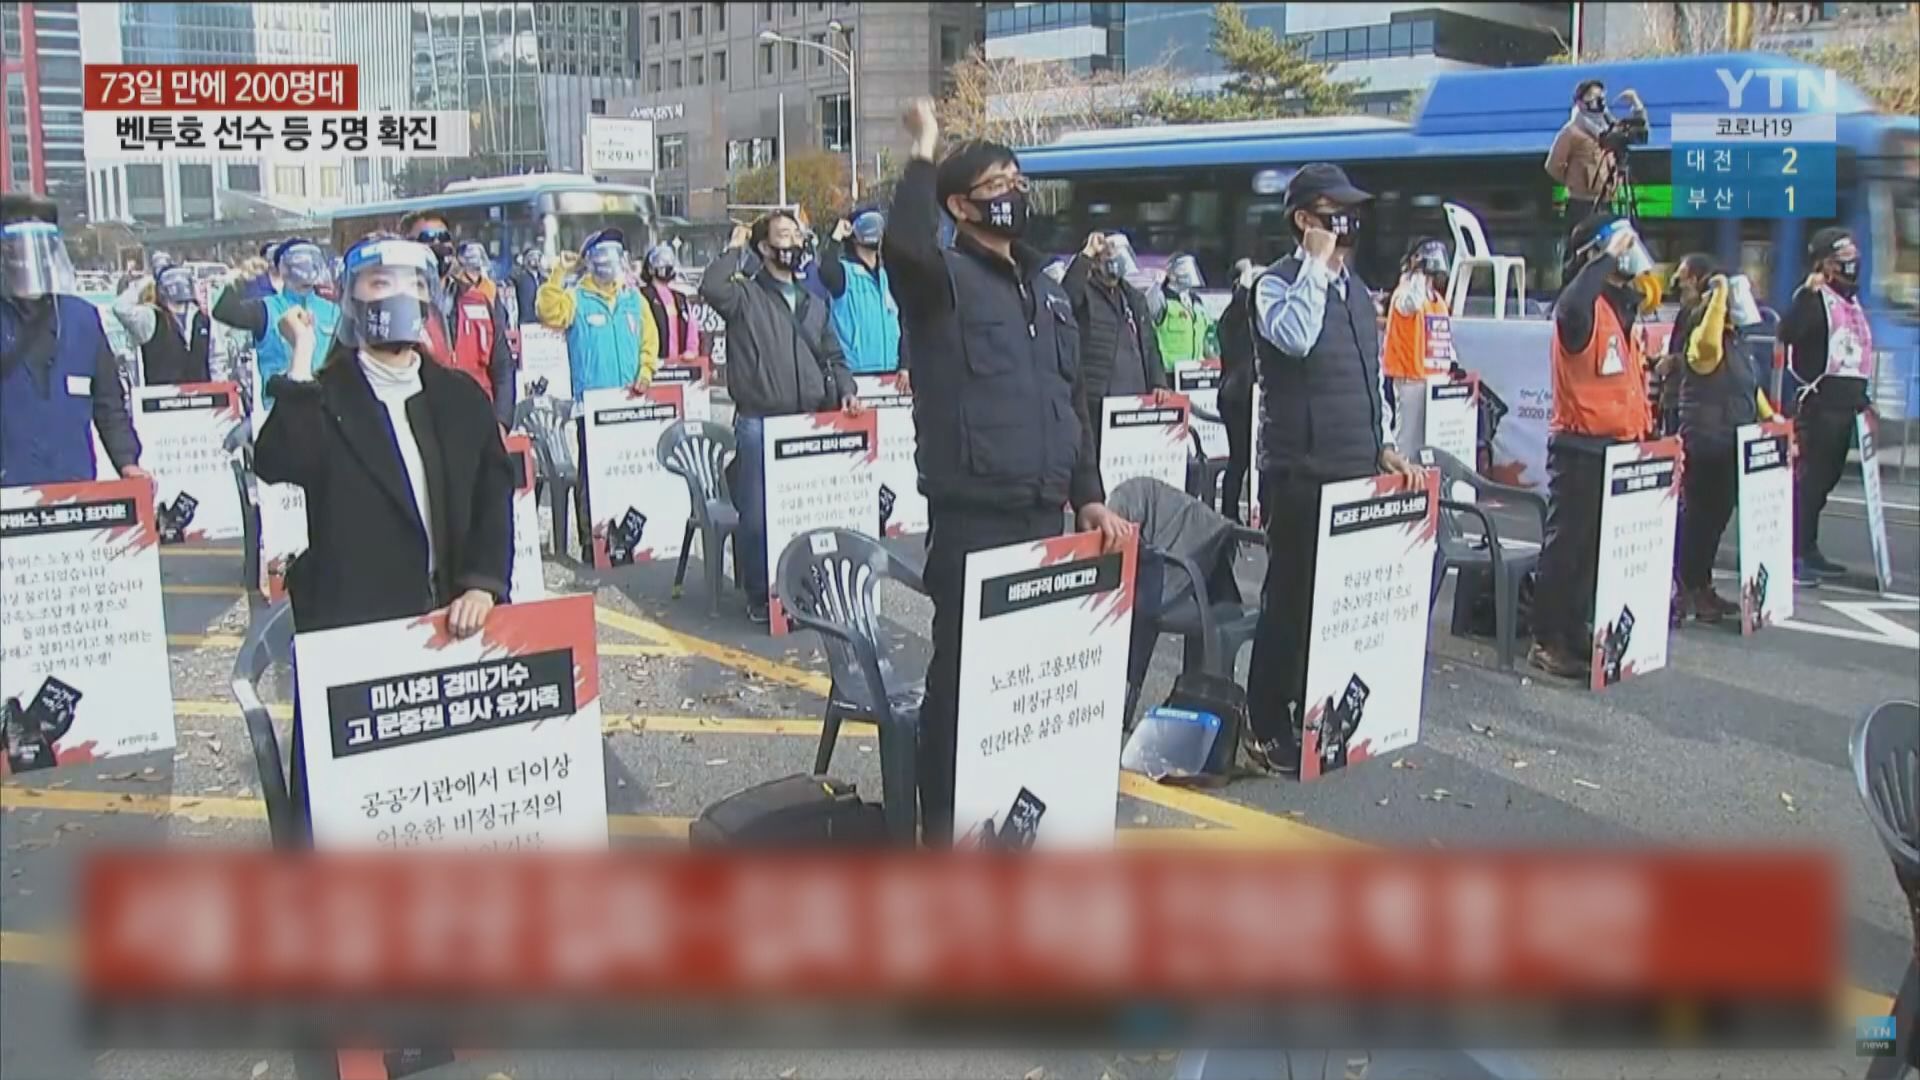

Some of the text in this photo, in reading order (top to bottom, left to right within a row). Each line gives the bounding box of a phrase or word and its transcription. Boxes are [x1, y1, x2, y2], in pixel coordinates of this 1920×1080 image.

[1008, 575, 1053, 602] 비정규직
[370, 663, 529, 711] 마사회 경마기수
[348, 684, 560, 745] 고 문중원 열사 유가족
[361, 767, 498, 819] 공공기관에서
[454, 791, 562, 833] 비정규직의
